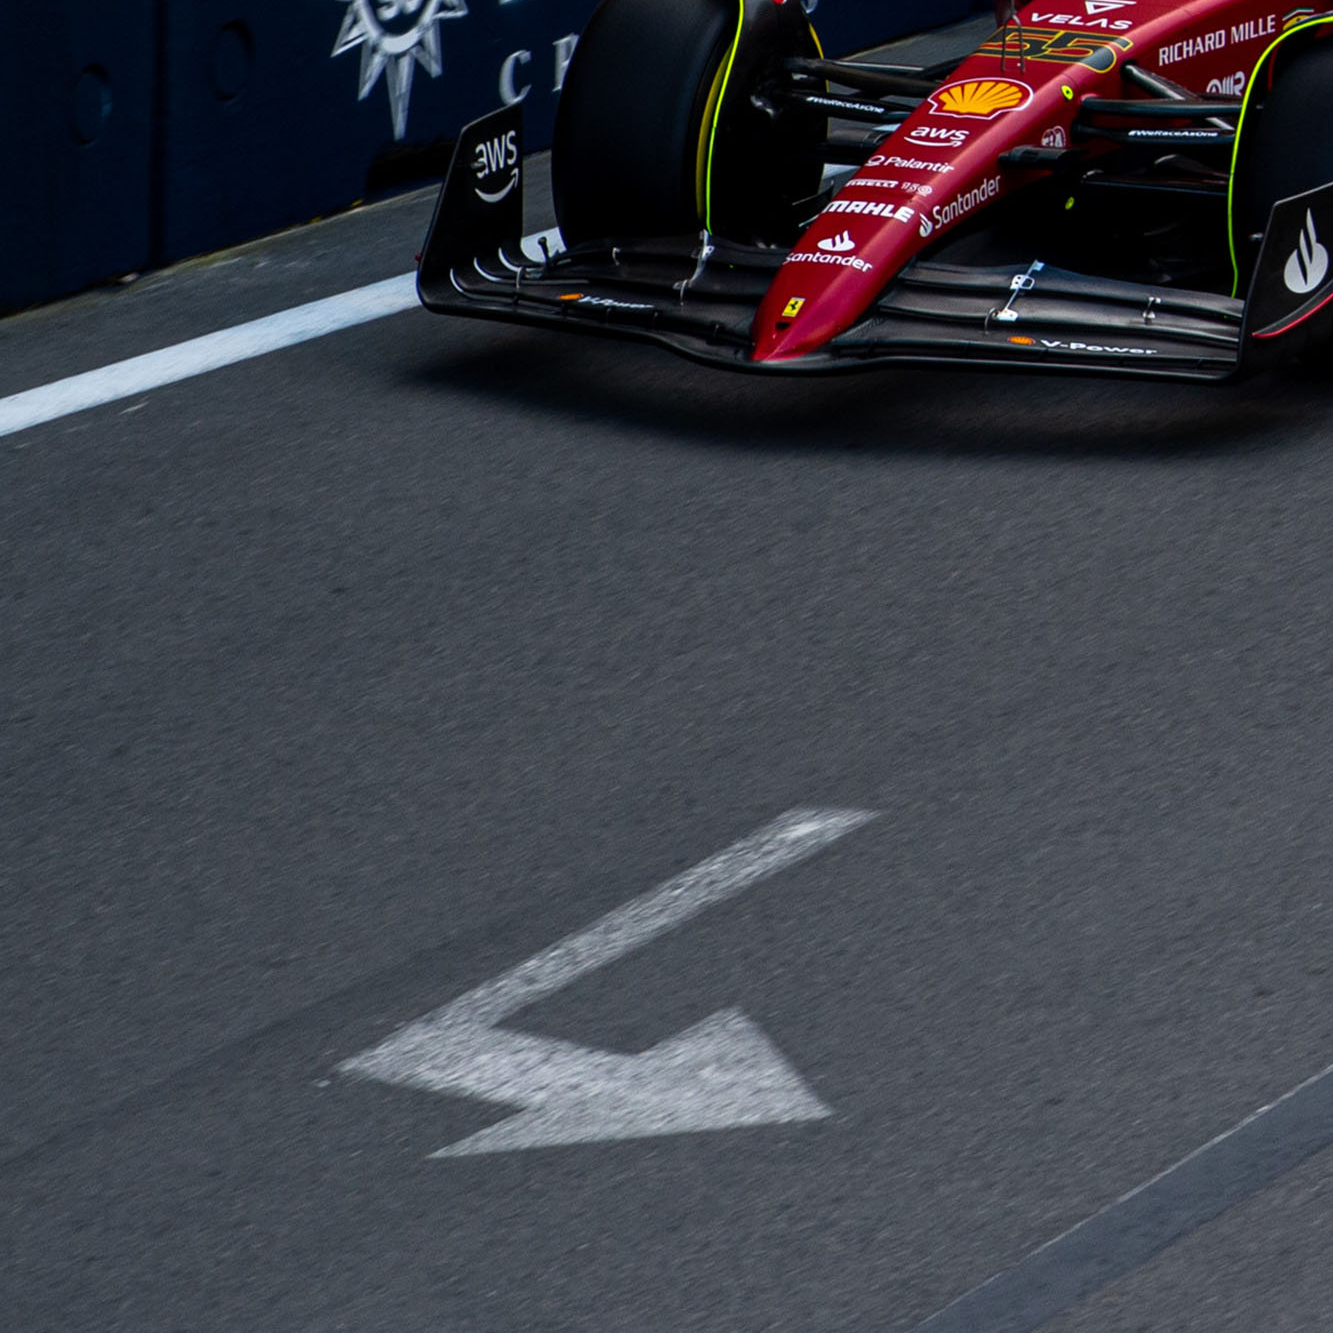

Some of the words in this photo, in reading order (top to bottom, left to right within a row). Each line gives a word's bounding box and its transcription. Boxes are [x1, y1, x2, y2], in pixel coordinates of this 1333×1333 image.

[1031, 12, 1132, 31] VELAS
[969, 25, 1134, 75] 55
[1159, 29, 1225, 66] RICHARD
[1230, 14, 1276, 44] MILLE
[910, 125, 970, 141] aws
[474, 130, 518, 179] aws
[883, 155, 955, 174] Palantir
[822, 201, 915, 223] MAHLE
[932, 175, 1001, 229] Santander
[782, 252, 873, 272] Santander
[1040, 339, 1157, 354] V-Power
